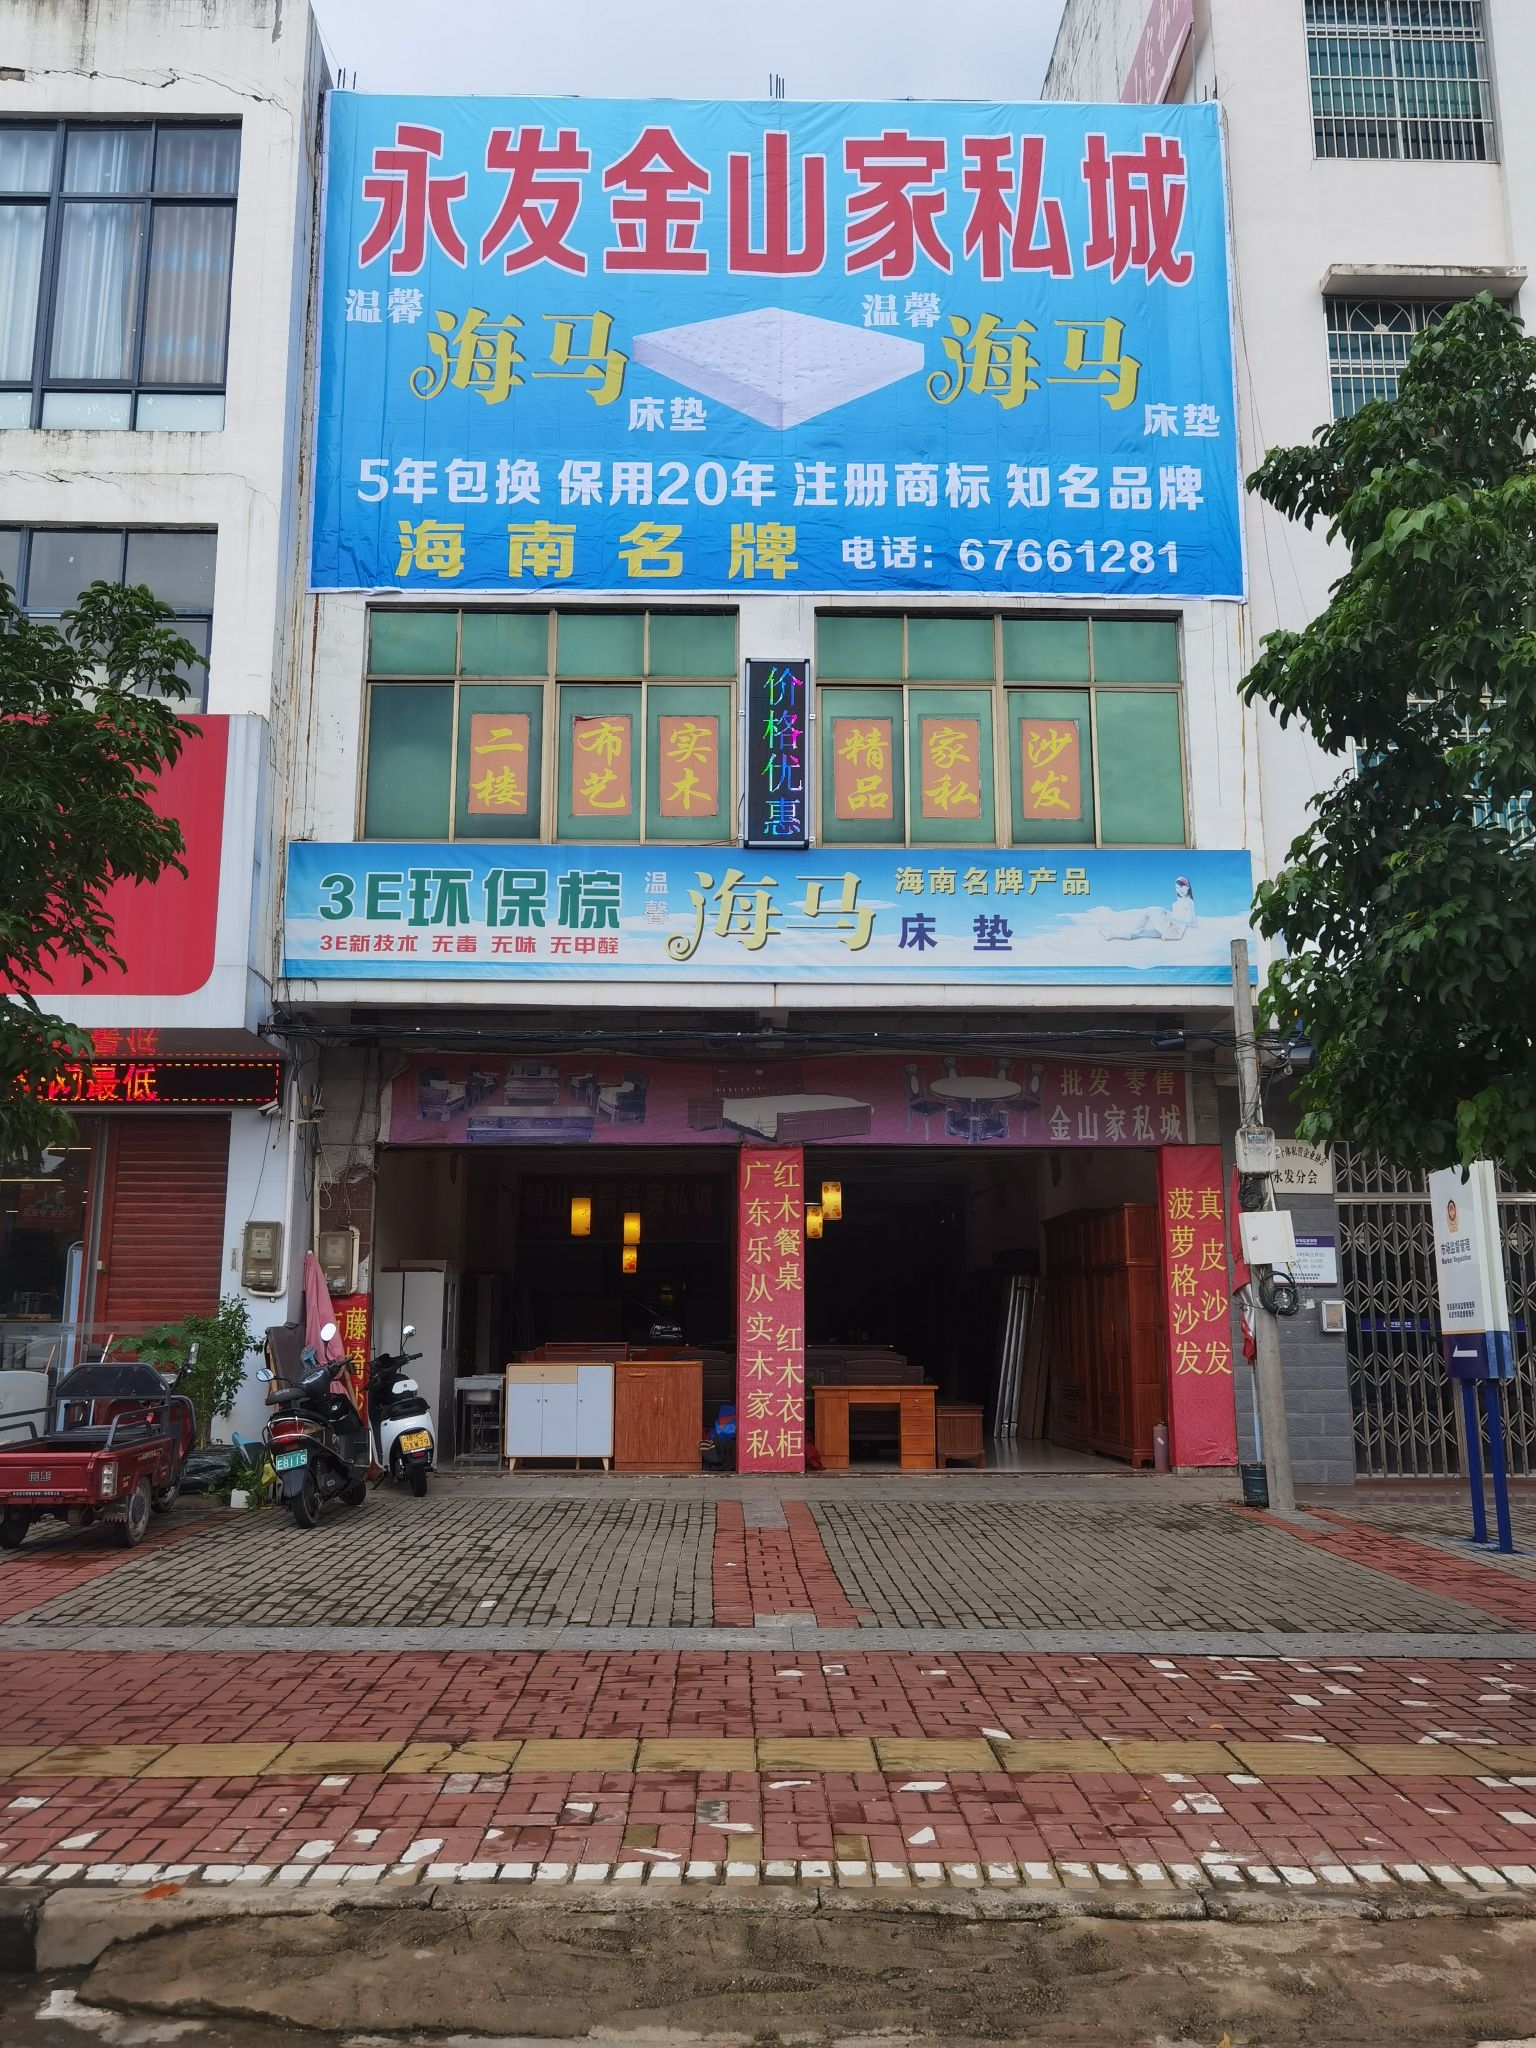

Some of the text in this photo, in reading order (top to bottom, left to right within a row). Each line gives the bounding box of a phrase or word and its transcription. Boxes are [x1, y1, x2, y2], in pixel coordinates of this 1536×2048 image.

[358, 123, 1196, 287] 永发金山家私城
[345, 288, 425, 325] 温馨
[863, 292, 941, 328] 温馨
[409, 307, 630, 407] 海马
[926, 313, 1142, 411] 海马
[628, 396, 708, 432] 床垫
[1143, 403, 1221, 438] 床垫
[358, 458, 1205, 511] 5年包换 保用20年 注册商标 知名品牌
[395, 519, 799, 579] 海南名牌
[959, 538, 1178, 574] 67661281
[471, 728, 526, 807] 二楼
[577, 722, 626, 809] 布艺
[666, 722, 712, 810] 实木
[762, 666, 804, 836] 价格优惠
[838, 726, 889, 811] 精品
[924, 726, 978, 811] 家私
[1027, 727, 1073, 811] 沙发
[319, 867, 622, 929] 3E环保棕
[643, 870, 671, 926] 温馨
[664, 869, 877, 961] 海马
[894, 866, 1092, 896] 海南名牌产品
[319, 934, 620, 955] 3E新技术 无毒 无味 无甲醛
[898, 912, 1014, 952] 床垫
[1060, 1068, 1176, 1097] 批发 零售
[1048, 1103, 1183, 1143] 金山家私城
[773, 1160, 802, 1292] 红木餐桌
[744, 1161, 775, 1460] 广东乐从实木家私
[1168, 1187, 1204, 1375] 菠萝格沙发
[1197, 1187, 1233, 1375] 真皮沙发
[776, 1323, 805, 1459] 红木衣柜
[276, 1453, 307, 1470] E8115
